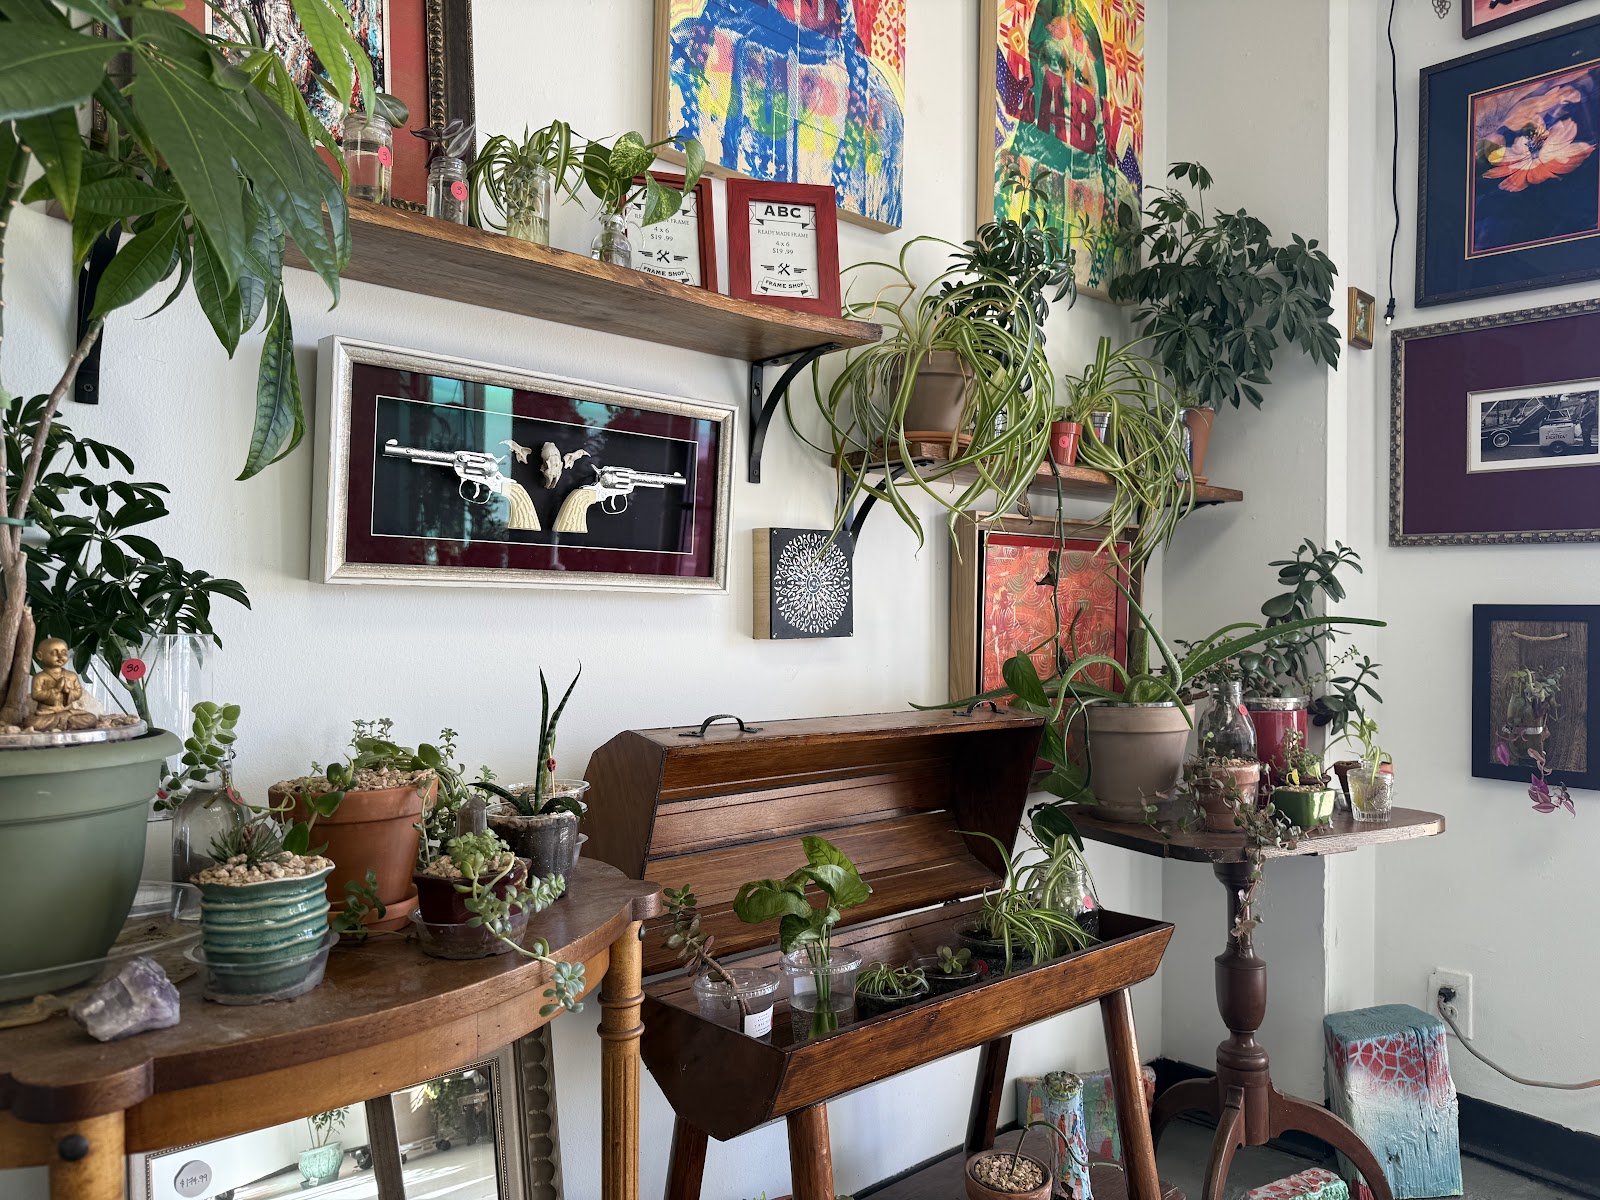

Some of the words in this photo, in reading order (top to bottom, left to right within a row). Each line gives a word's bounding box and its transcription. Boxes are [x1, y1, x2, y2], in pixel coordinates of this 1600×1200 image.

[382, 151, 388, 161] 3
[763, 204, 802, 219] ABC
[757, 228, 775, 236] READY
[643, 266, 667, 277] FRAME
[765, 279, 787, 289] FRAME
[179, 1173, 208, 1189] $174.99
